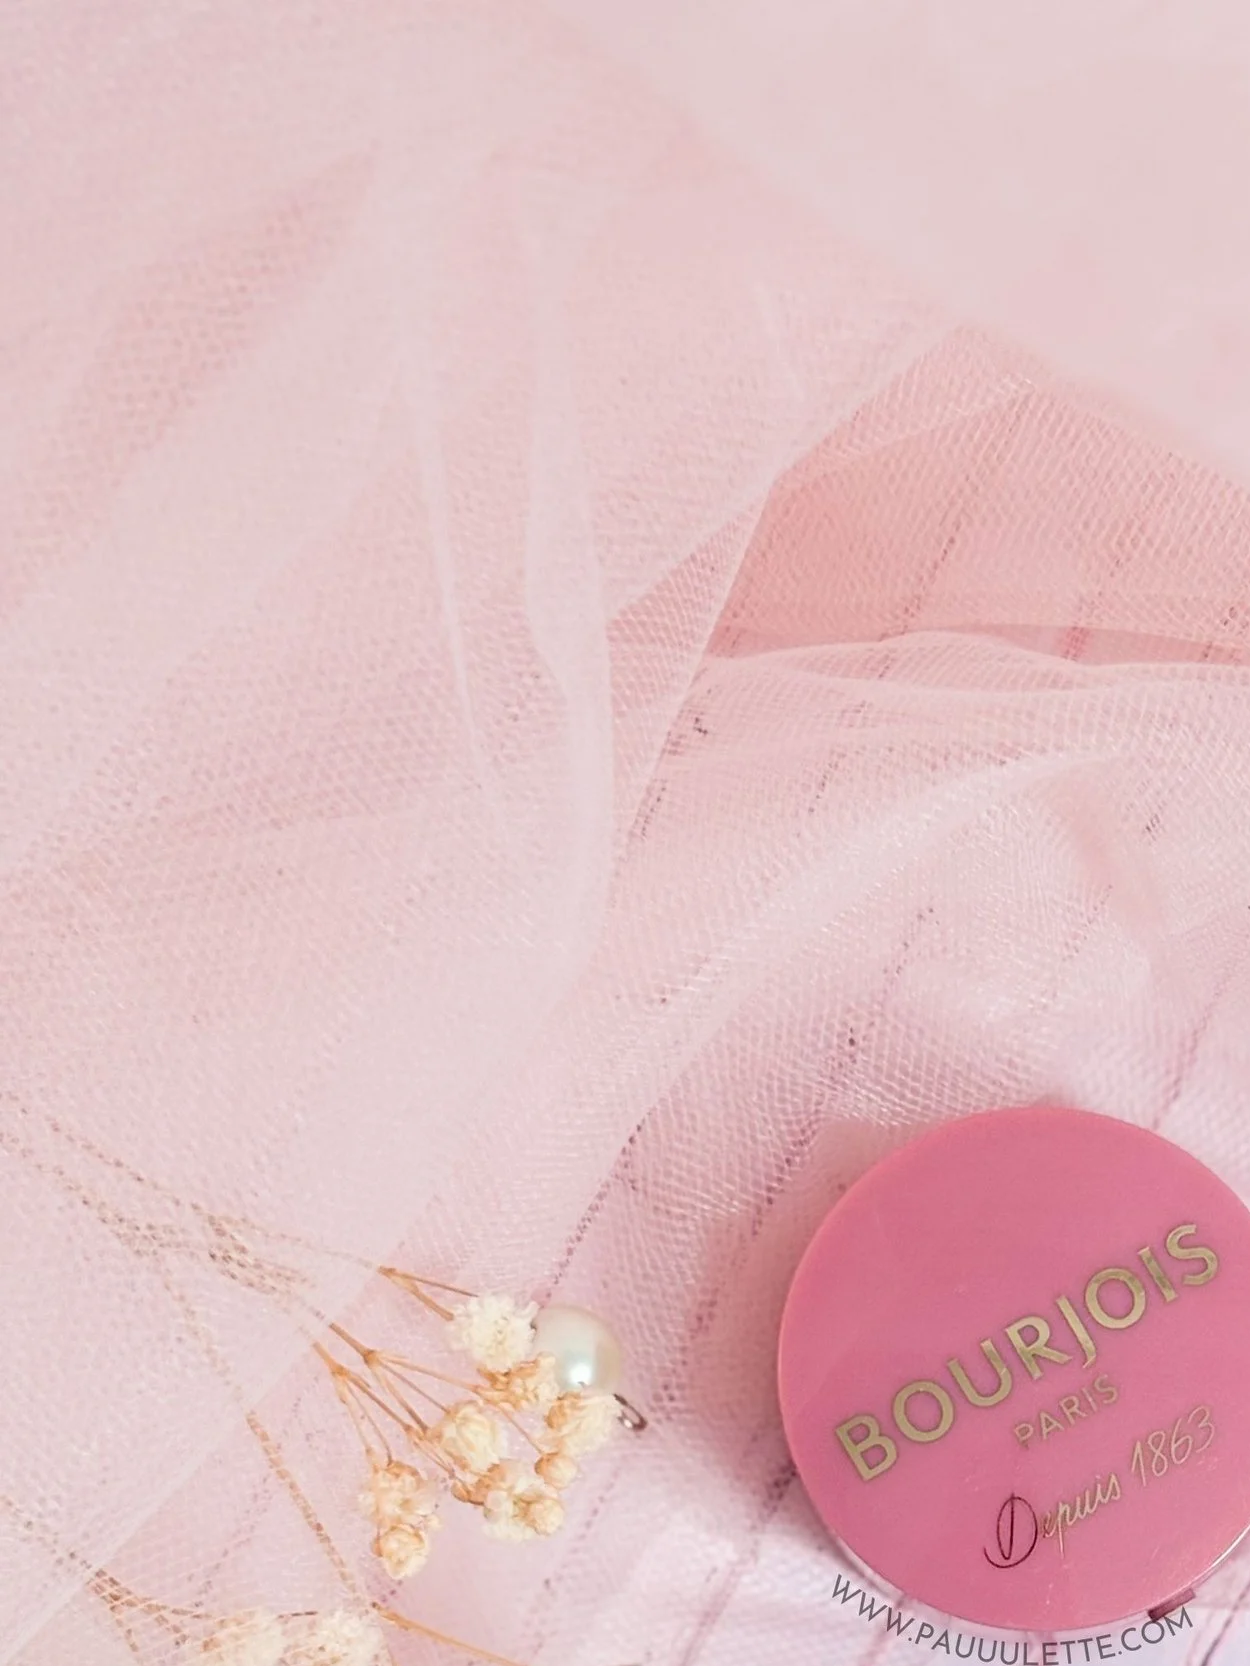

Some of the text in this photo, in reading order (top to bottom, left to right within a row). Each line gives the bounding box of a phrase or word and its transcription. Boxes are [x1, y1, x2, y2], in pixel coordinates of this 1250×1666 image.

[834, 1223, 1219, 1481] BOURJOIS
[1013, 1373, 1119, 1449] PARIS
[983, 1405, 1217, 1569] Depuis 1863
